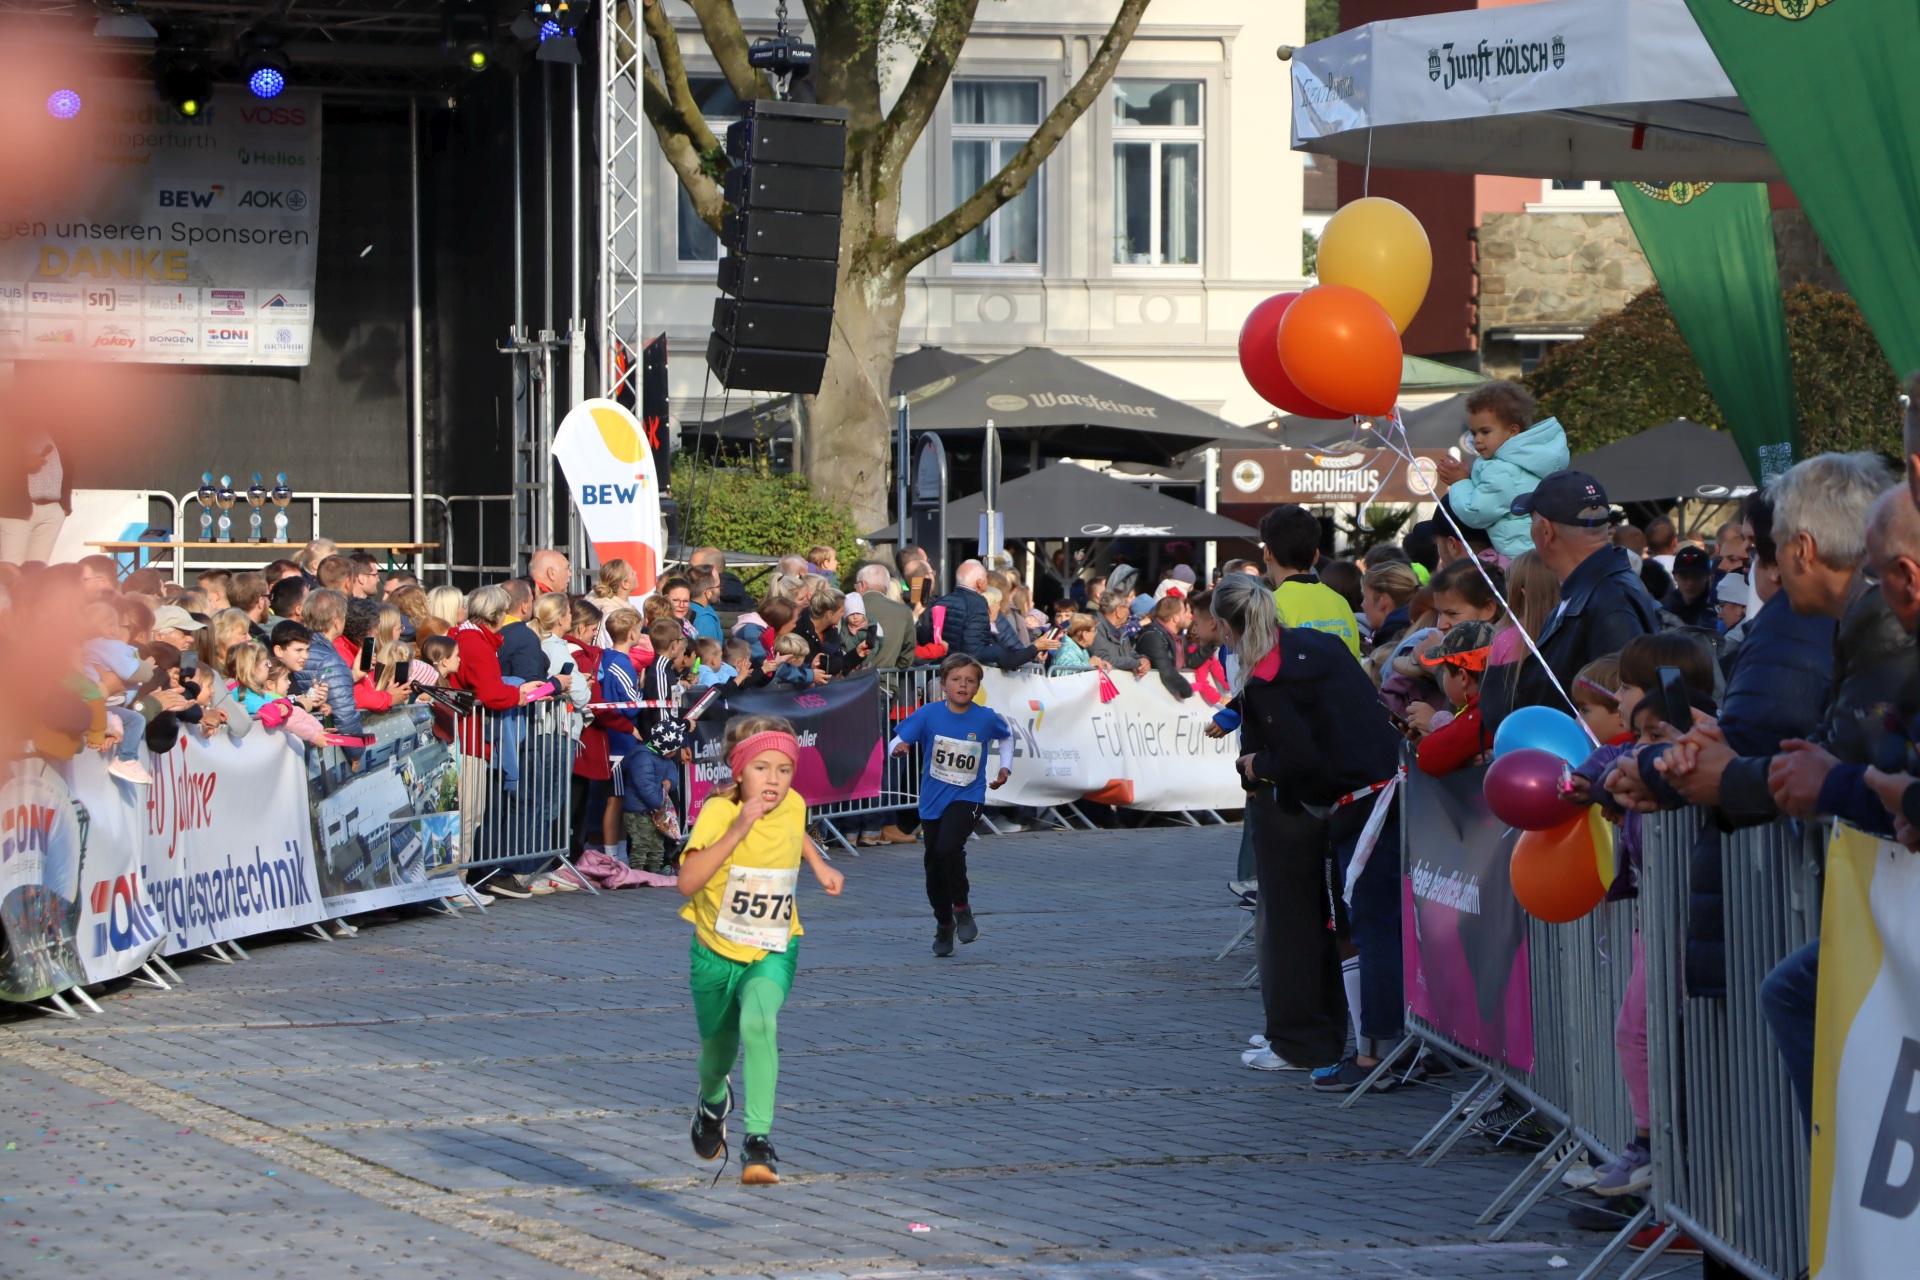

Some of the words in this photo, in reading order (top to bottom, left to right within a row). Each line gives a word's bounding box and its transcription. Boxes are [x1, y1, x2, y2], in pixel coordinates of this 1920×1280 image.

[1496, 38, 1549, 76] KÖLSCH
[240, 105, 307, 126] VOSS
[253, 151, 306, 166] Helios
[159, 190, 214, 208] BEW
[238, 190, 283, 208] AOK
[56, 221, 162, 241] unseren
[171, 222, 310, 246] Sponsoren
[39, 246, 188, 280] DANKE
[149, 335, 194, 344] BONGEN
[220, 329, 249, 341] ONI
[1029, 391, 1158, 418] Warsteiner
[1290, 469, 1380, 493] BRAUHAUS
[582, 483, 639, 505] BEW
[793, 693, 828, 709] VOSS
[1126, 712, 1169, 757] hier.
[935, 748, 976, 770] 5160
[167, 735, 217, 860] Jahre
[730, 889, 793, 921] 5573
